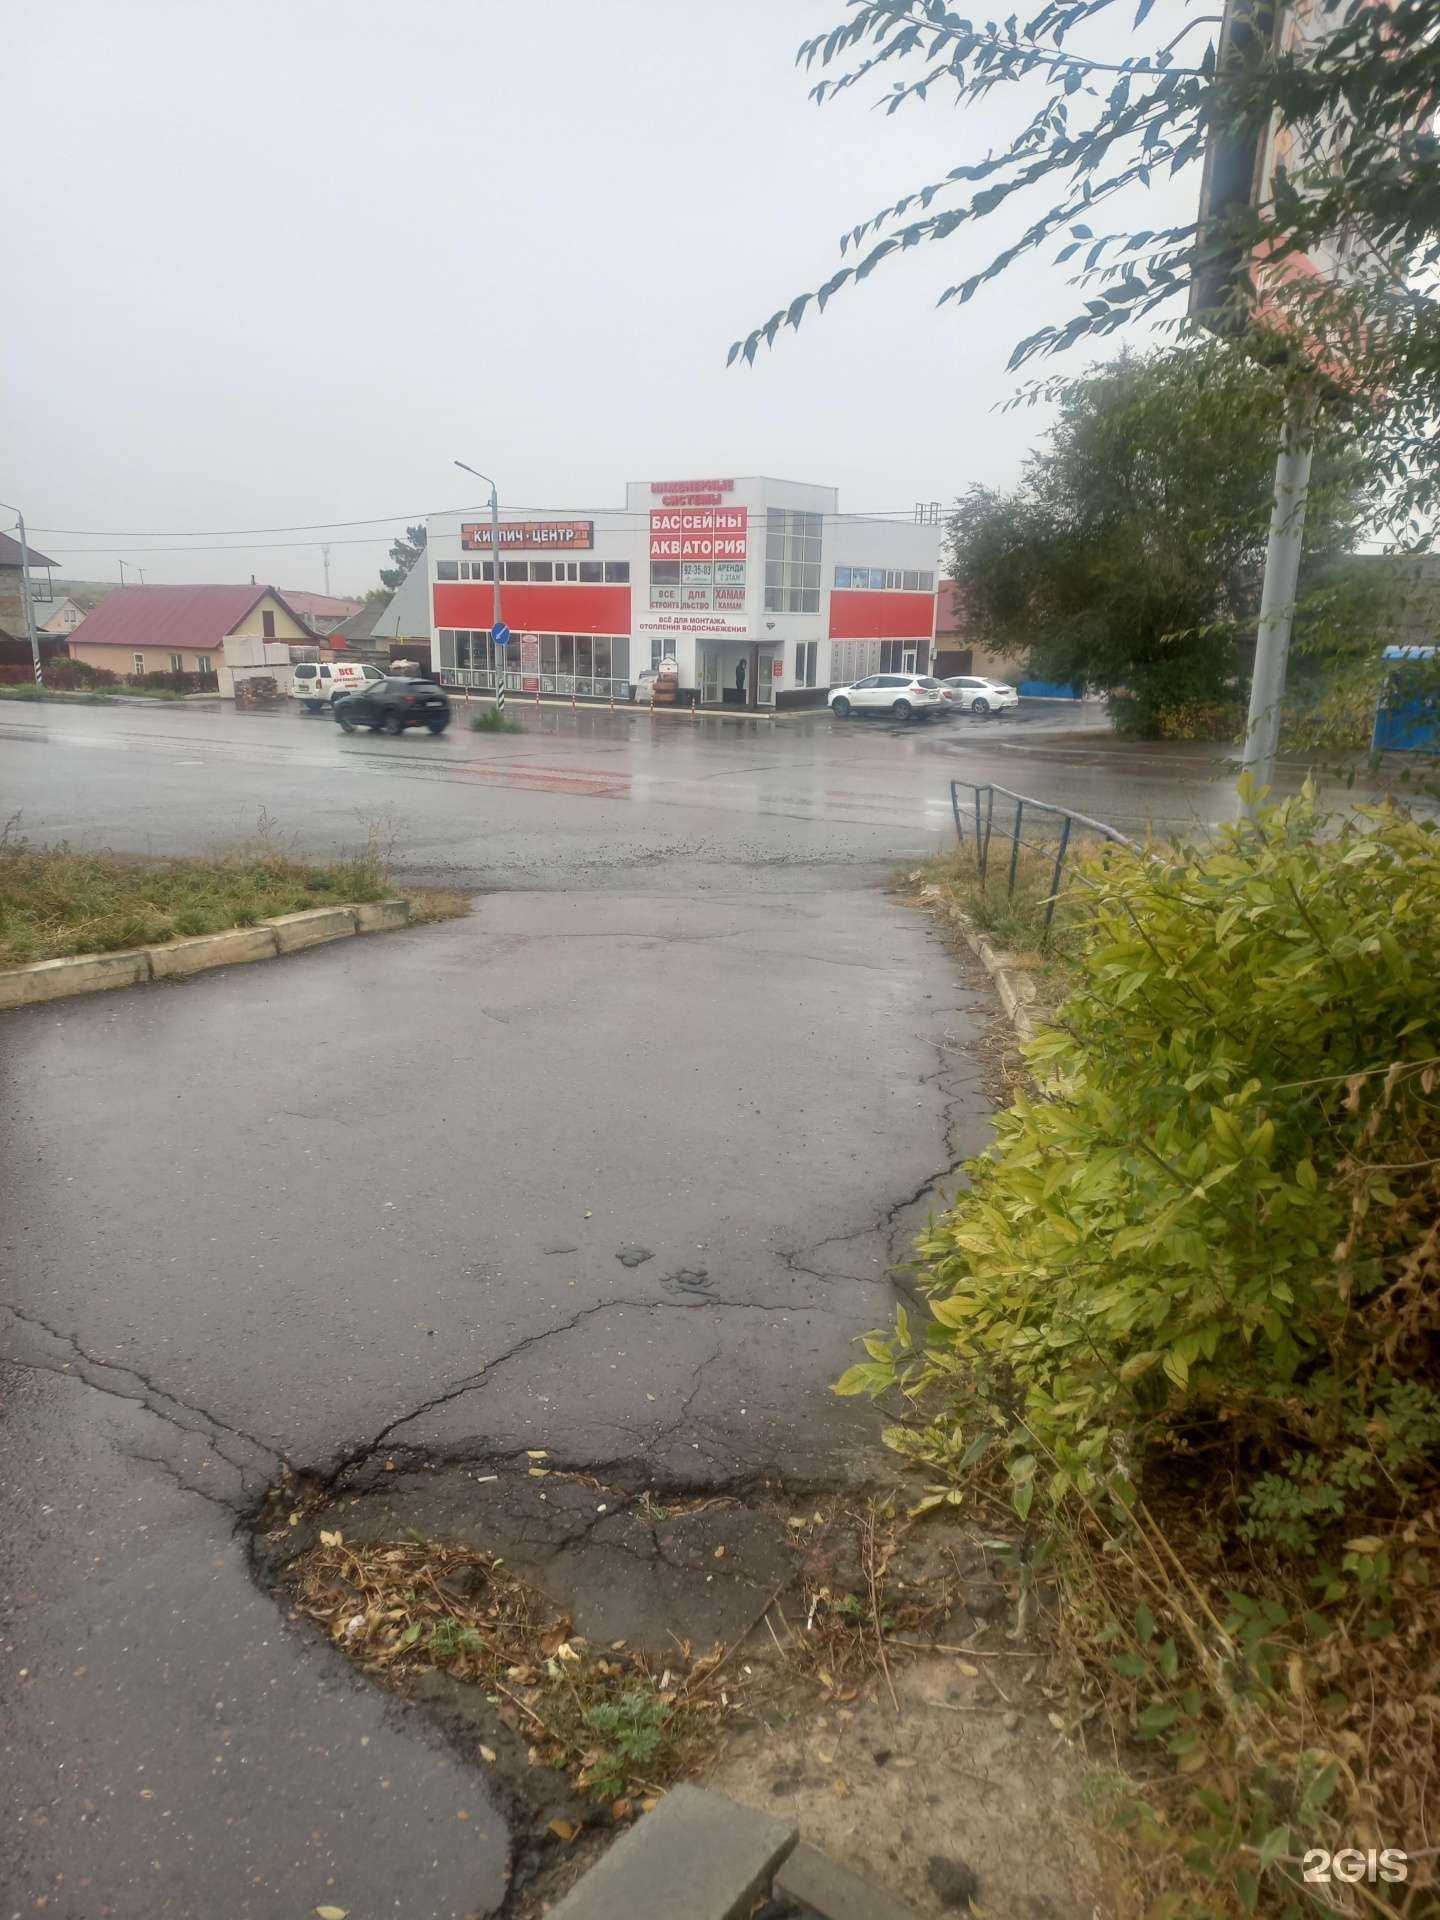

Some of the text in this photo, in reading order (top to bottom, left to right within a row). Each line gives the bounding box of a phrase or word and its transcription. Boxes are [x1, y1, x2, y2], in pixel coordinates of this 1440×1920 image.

[652, 512, 742, 529] БАССЕЙНЫ
[651, 540, 746, 554] АКВАТОРИЯ
[717, 564, 743, 572] АРЕНДА
[659, 590, 706, 600] ВСЕ ДЛЯ
[690, 617, 726, 625] МОНТАЖА
[682, 624, 747, 633] ВОДОСНАБЖЕНИЯ
